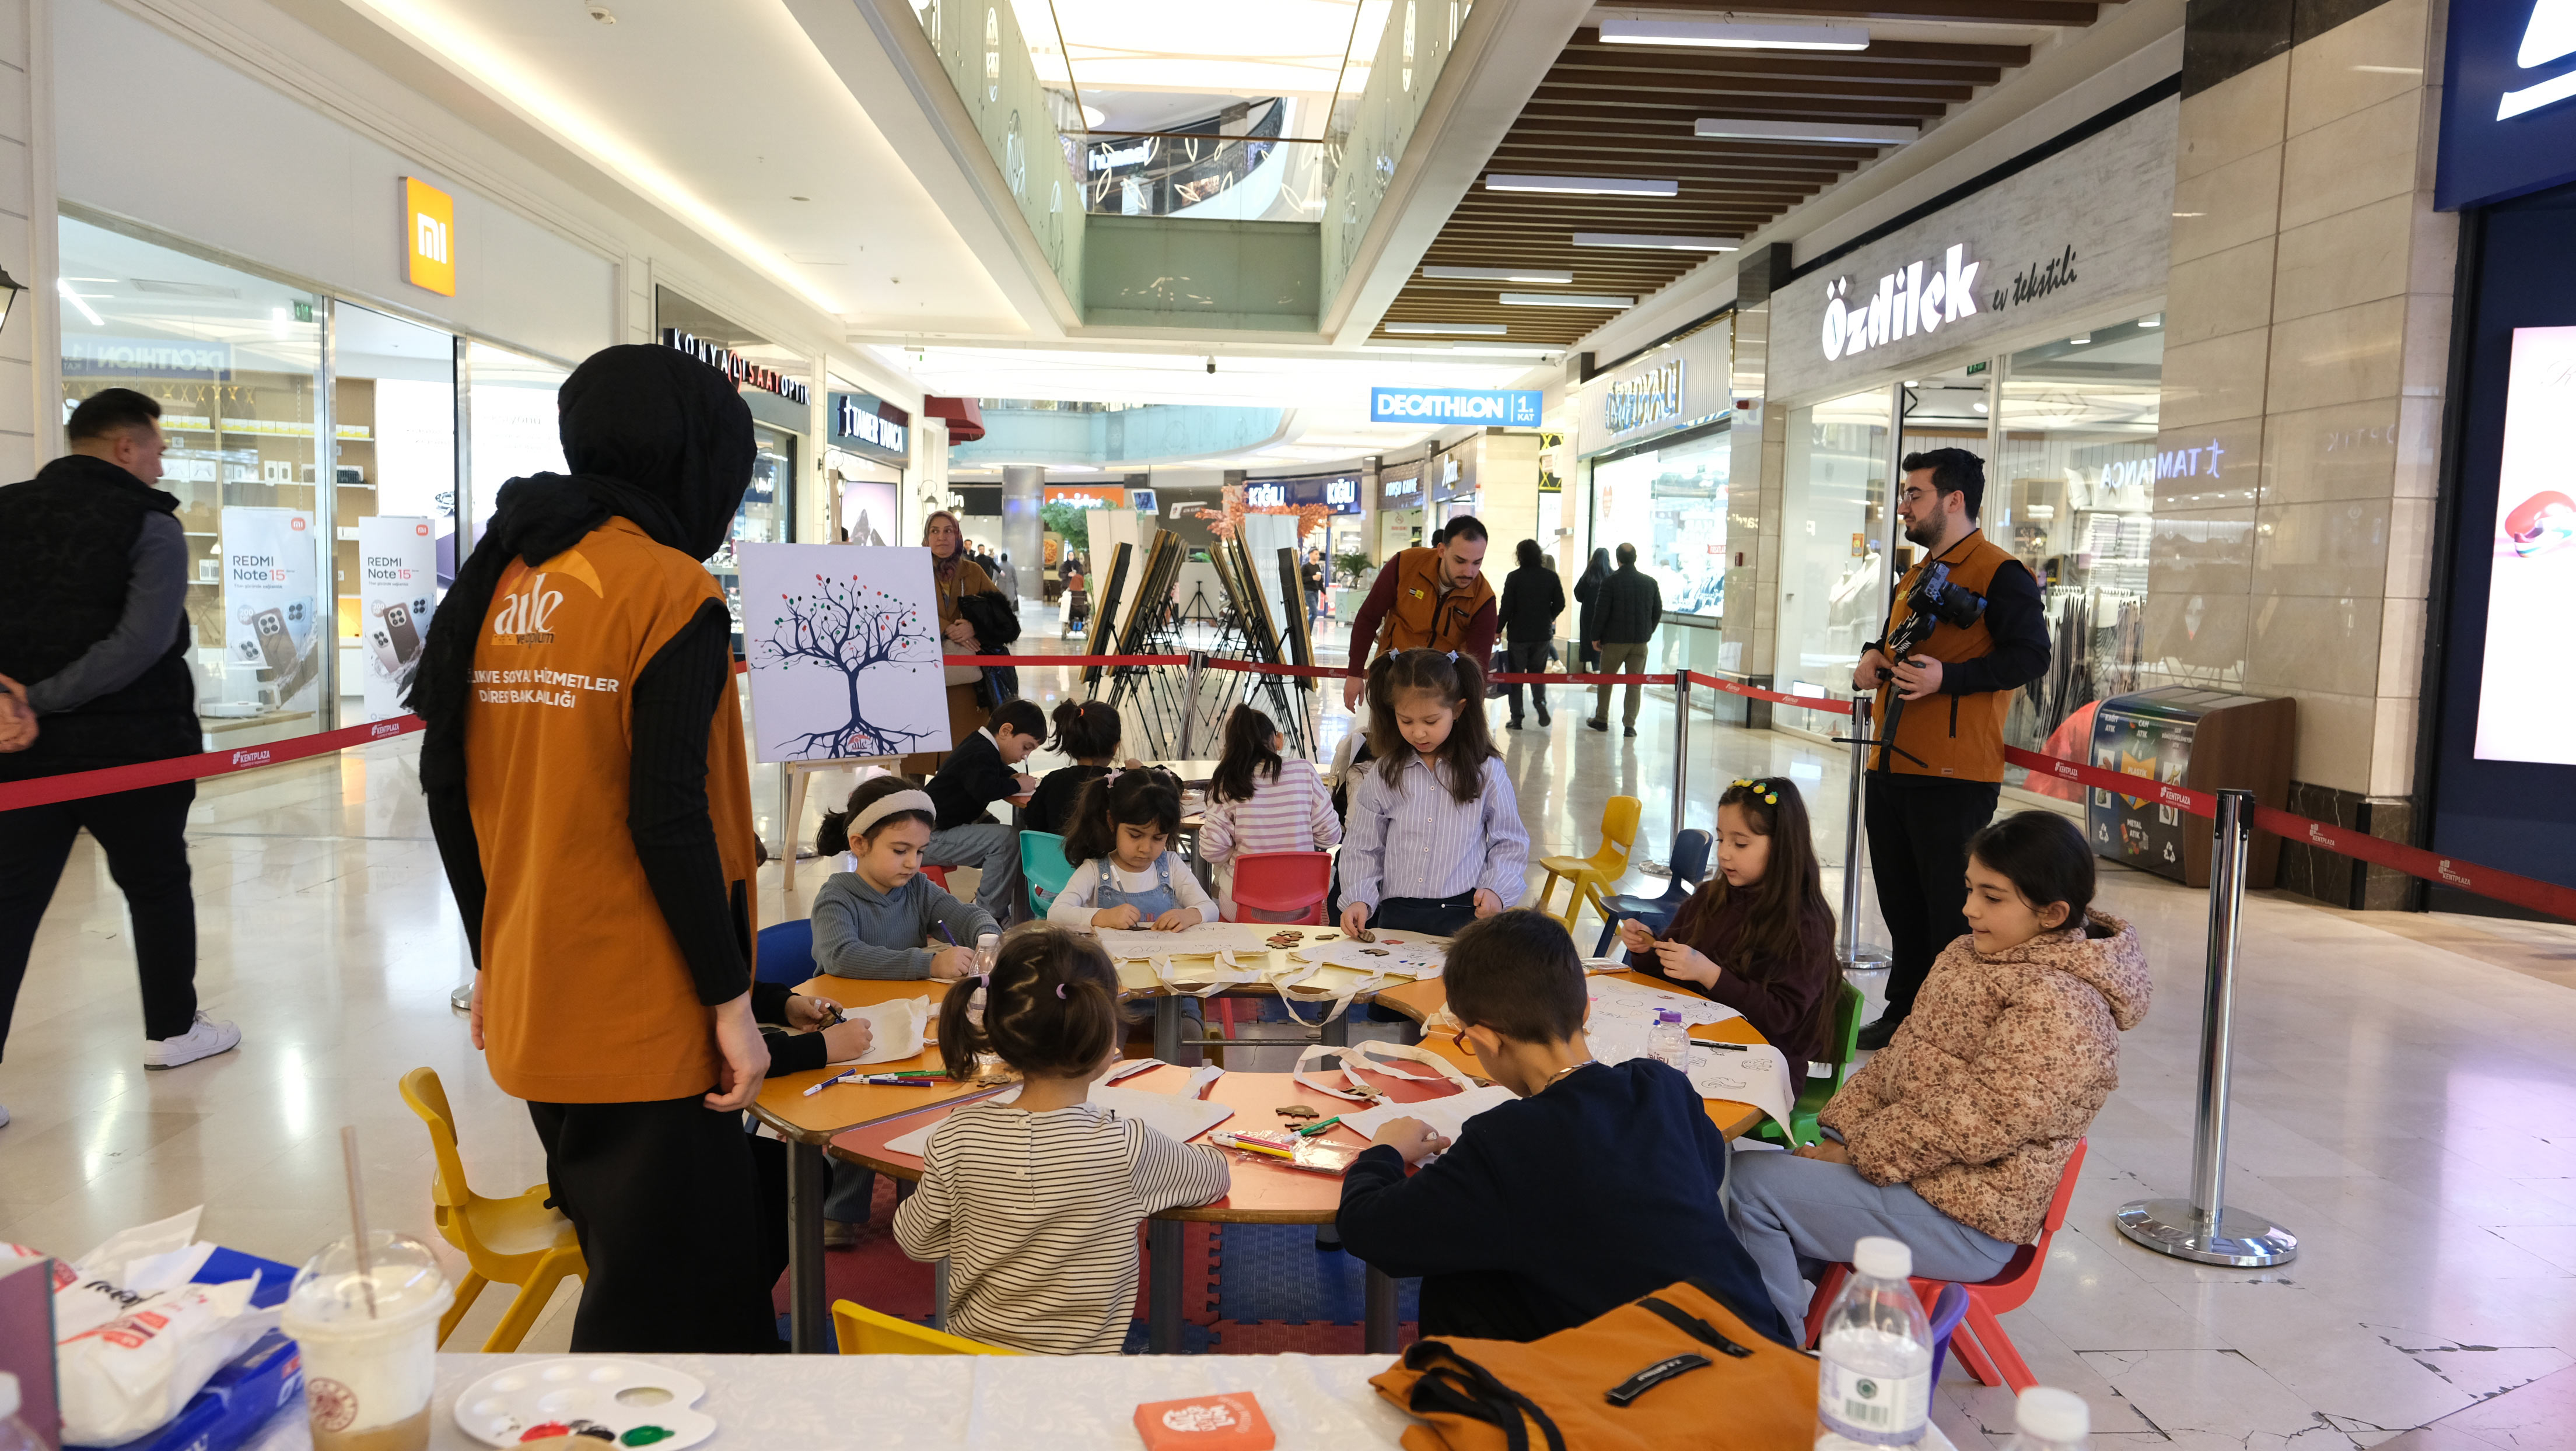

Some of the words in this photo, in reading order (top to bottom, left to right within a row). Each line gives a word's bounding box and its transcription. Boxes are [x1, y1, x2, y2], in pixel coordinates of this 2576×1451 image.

[1822, 243, 1980, 361] Özdilek
[1992, 288, 2008, 311] ev
[2013, 244, 2077, 306] tekstili
[749, 360, 779, 394] SAAT
[1377, 394, 1504, 418] DECATHLON
[1517, 395, 1534, 413] 1.
[233, 555, 274, 567] REDMI
[368, 557, 402, 567] REDMI
[233, 569, 268, 581] Note
[269, 569, 286, 581] 15
[368, 569, 396, 579] Note
[398, 569, 411, 579] 15
[534, 667, 620, 692] HİZMETLER
[377, 723, 399, 734] KENTPLAZA
[2105, 724, 2116, 732] ATIK
[2138, 719, 2150, 728] CAM
[2136, 730, 2148, 738] ATIK
[240, 751, 271, 763] KENTPLAZA
[2059, 766, 2078, 777] KENTPLAZA
[2127, 766, 2147, 777] PLASTİK
[2166, 791, 2191, 806] KENTPLAZA
[2127, 818, 2142, 830] METAL
[2129, 829, 2140, 839] ATIK
[2312, 835, 2335, 846] KENTPLAZA
[2442, 871, 2471, 886] KENTPLAZA
